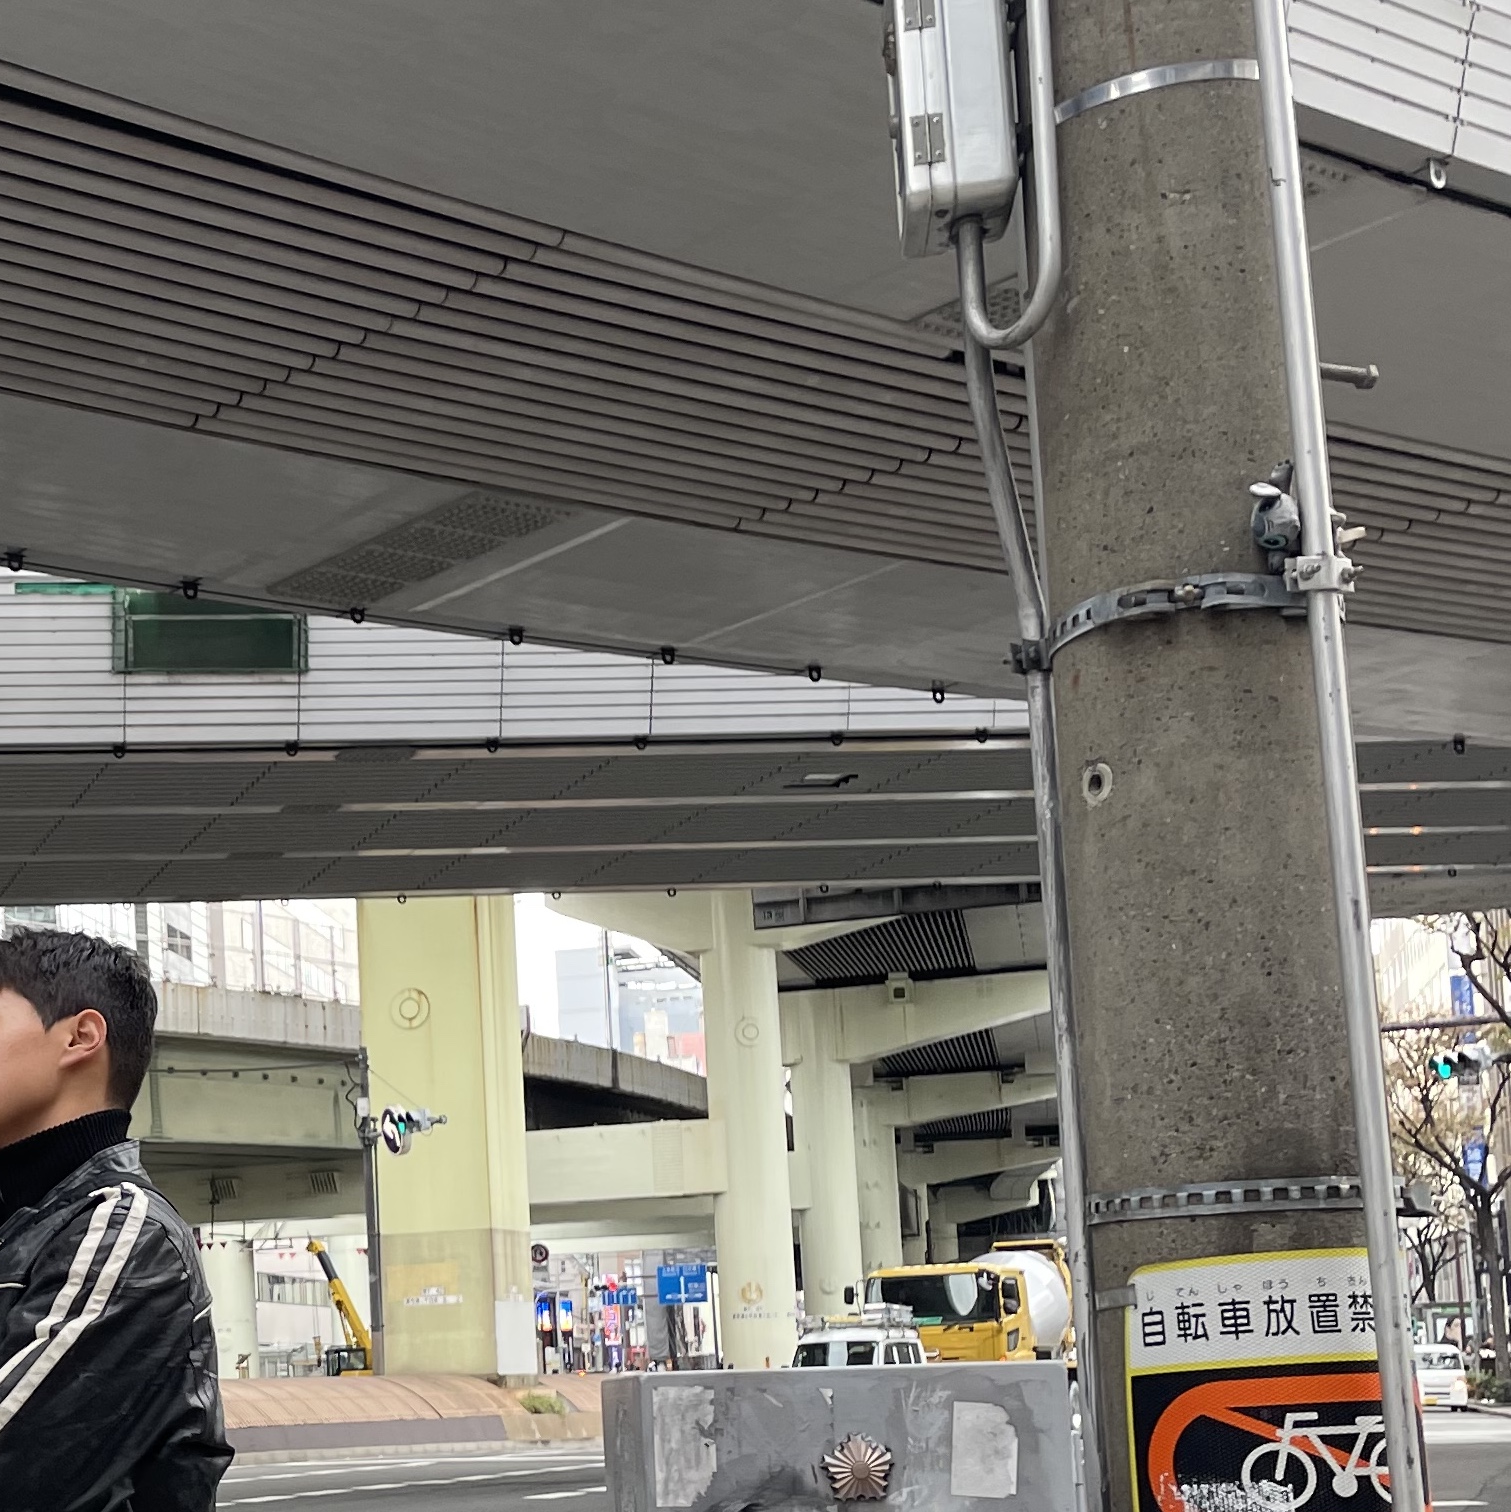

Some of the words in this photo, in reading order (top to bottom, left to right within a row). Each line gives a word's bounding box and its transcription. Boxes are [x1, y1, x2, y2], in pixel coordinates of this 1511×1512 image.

[1174, 1286, 1200, 1298] てん
[1217, 1283, 1243, 1294] しゃ
[1263, 1278, 1289, 1290] ほう
[1316, 1276, 1327, 1288] ち
[1141, 1291, 1376, 1347] 自転車放置禁
